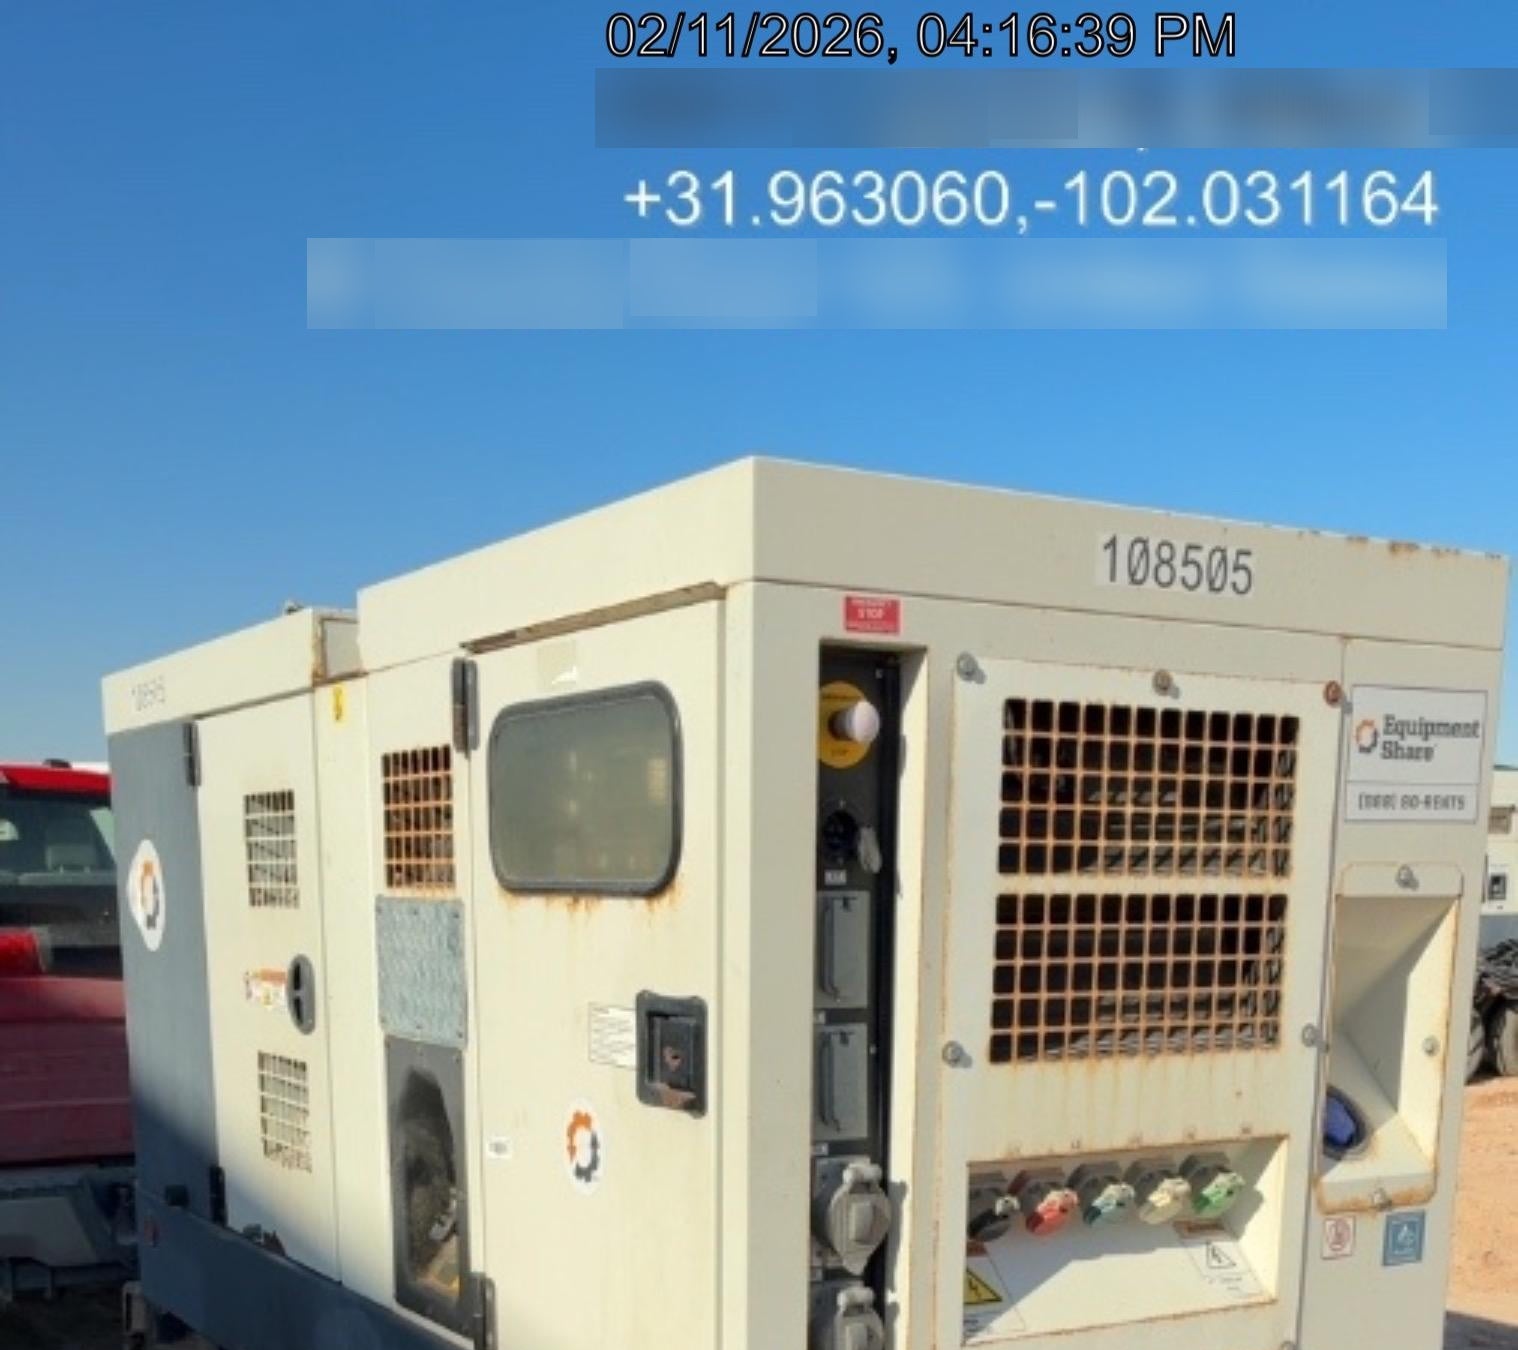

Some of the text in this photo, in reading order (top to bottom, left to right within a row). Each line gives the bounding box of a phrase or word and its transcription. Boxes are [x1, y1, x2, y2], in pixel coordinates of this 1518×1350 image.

[1103, 533, 1253, 595] 108505
[1382, 713, 1480, 741] Equipment
[1380, 740, 1434, 761] Share
